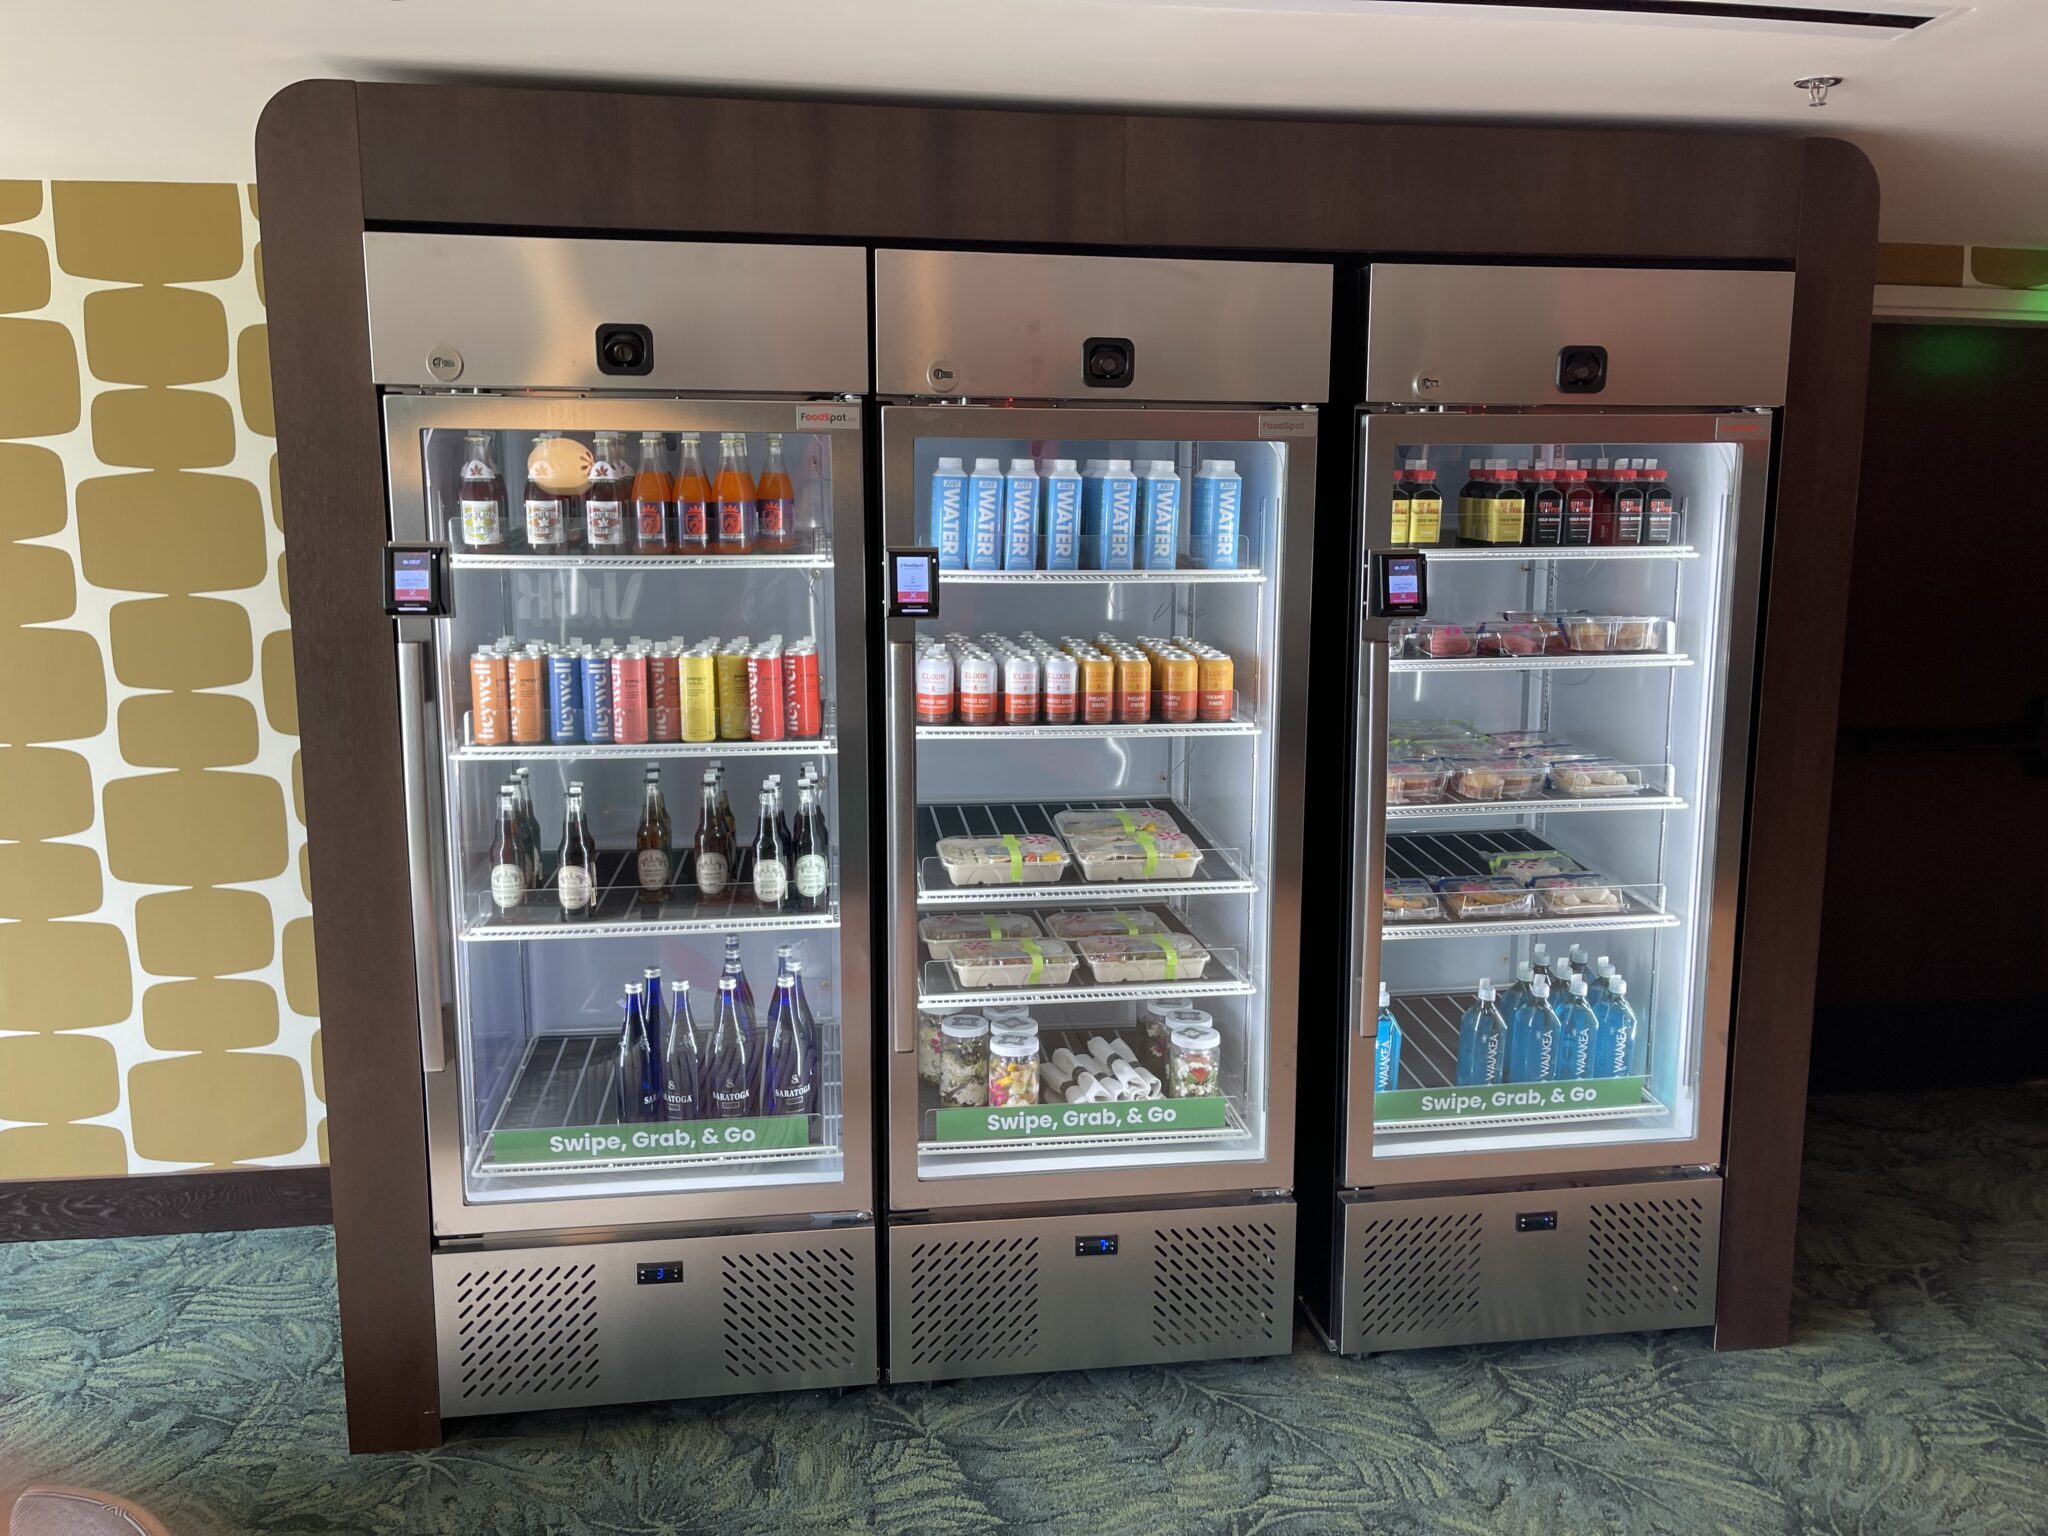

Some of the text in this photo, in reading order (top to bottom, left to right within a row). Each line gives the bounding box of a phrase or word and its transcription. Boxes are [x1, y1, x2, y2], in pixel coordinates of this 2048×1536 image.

[800, 413, 846, 424] FoodSpot
[1263, 422, 1304, 431] FoodSpot
[943, 488, 960, 554] WATER
[977, 489, 996, 555] WATER
[1012, 490, 1031, 555] WATER
[1055, 491, 1073, 556] WATER
[1112, 491, 1130, 556] WATER
[1154, 492, 1173, 556] WATER
[1217, 491, 1236, 555] WATER
[474, 663, 496, 739] heywell
[554, 662, 577, 737] heywell
[589, 662, 611, 738] heywell
[922, 672, 945, 680] ELIXIR
[712, 1089, 750, 1101] SARATOGA
[775, 1084, 810, 1097] SARATOGA
[988, 1106, 1176, 1134] Swipe, Grab, & Go
[1421, 1087, 1597, 1114] Swipe, Grab, & Go
[550, 1127, 756, 1156] Swipe, Grab, & Go
